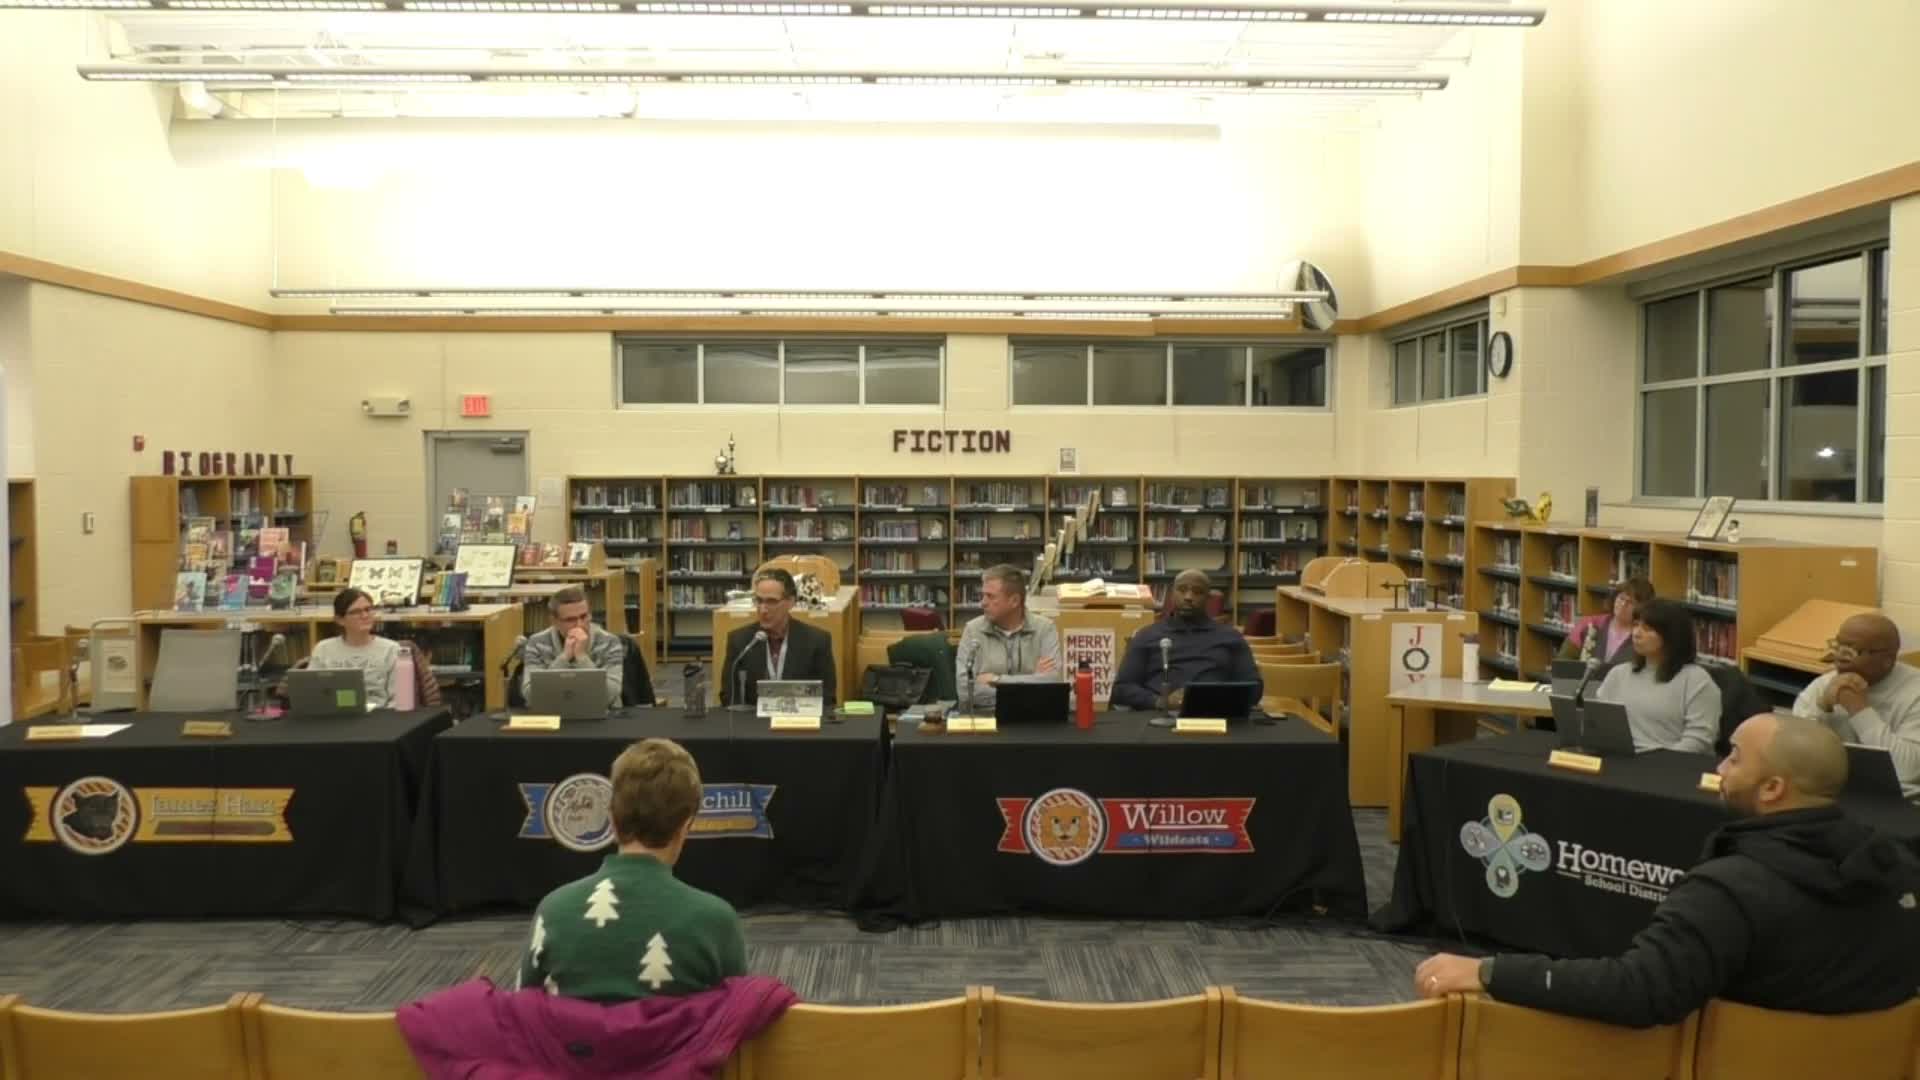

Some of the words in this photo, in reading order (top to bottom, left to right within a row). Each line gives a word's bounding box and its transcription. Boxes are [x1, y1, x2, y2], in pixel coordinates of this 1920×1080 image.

[893, 430, 1010, 453] FICTION
[163, 451, 293, 476] BIOGRAPHY
[1067, 635, 1111, 649] MERRY
[1067, 667, 1111, 681] MRY
[702, 791, 752, 809] chill
[1120, 803, 1227, 830] Willow
[1143, 833, 1210, 846] Wildcats
[1556, 840, 1685, 886] Homewo
[1583, 874, 1627, 894] School
[1628, 884, 1668, 903] Distri
